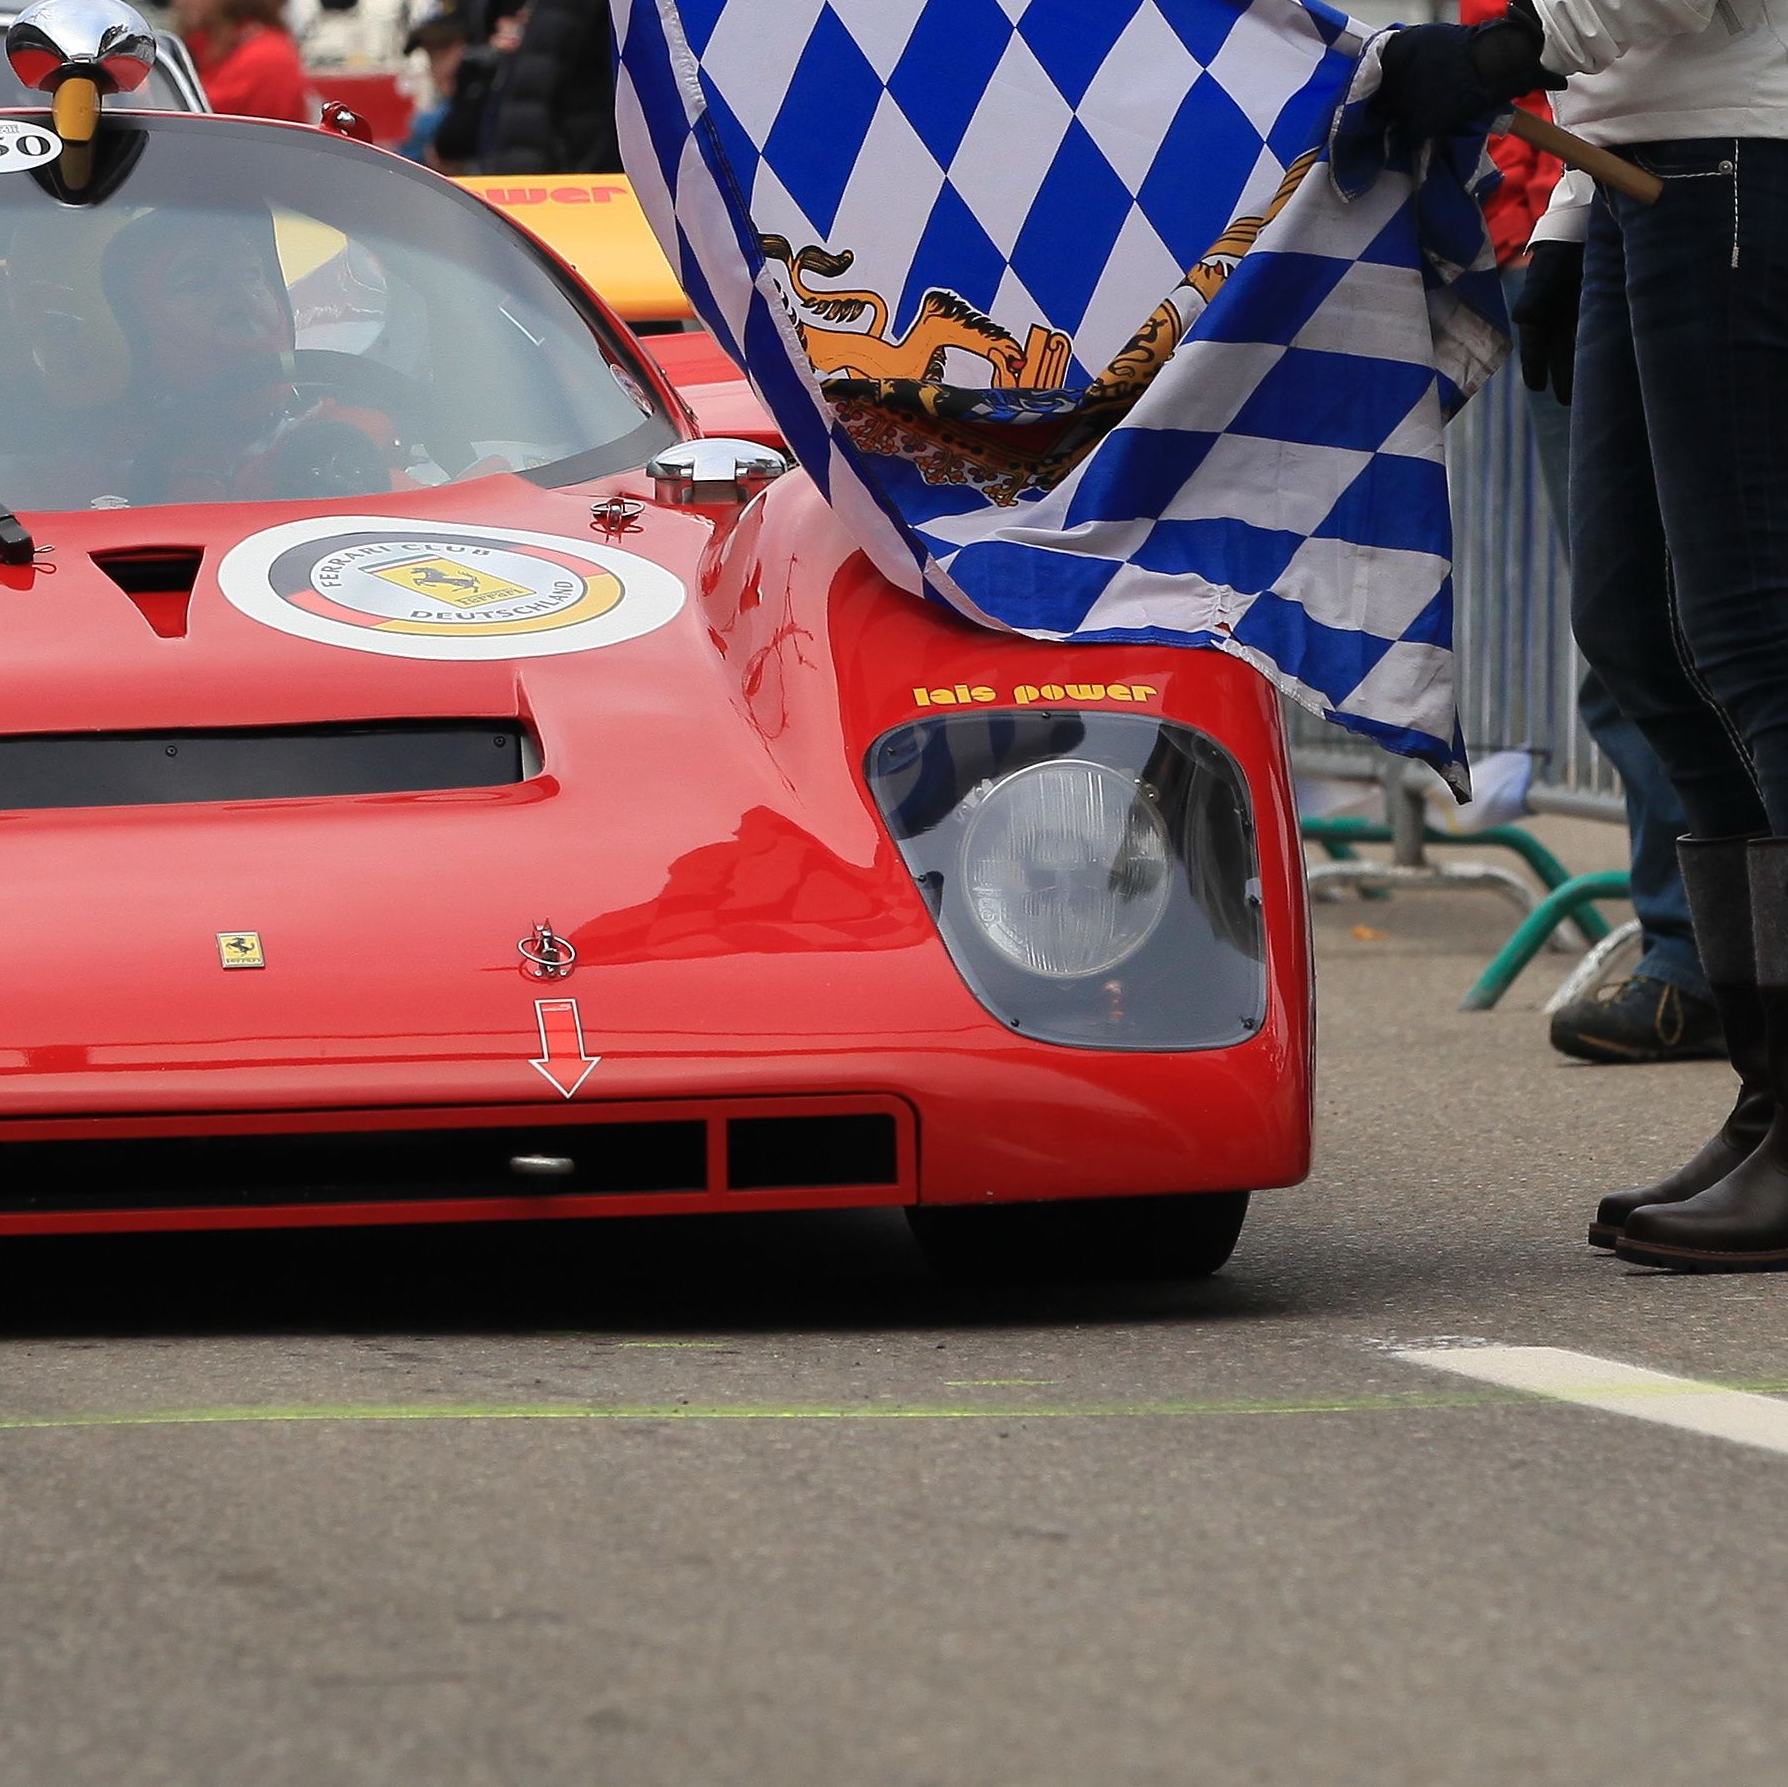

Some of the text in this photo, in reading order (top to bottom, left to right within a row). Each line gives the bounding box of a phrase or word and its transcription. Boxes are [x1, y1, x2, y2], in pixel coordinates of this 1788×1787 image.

[477, 186, 628, 206] wer
[318, 543, 492, 588] FERRARI CLUB
[410, 580, 574, 621] DEUTSCHLAND
[1013, 683, 1157, 705] power
